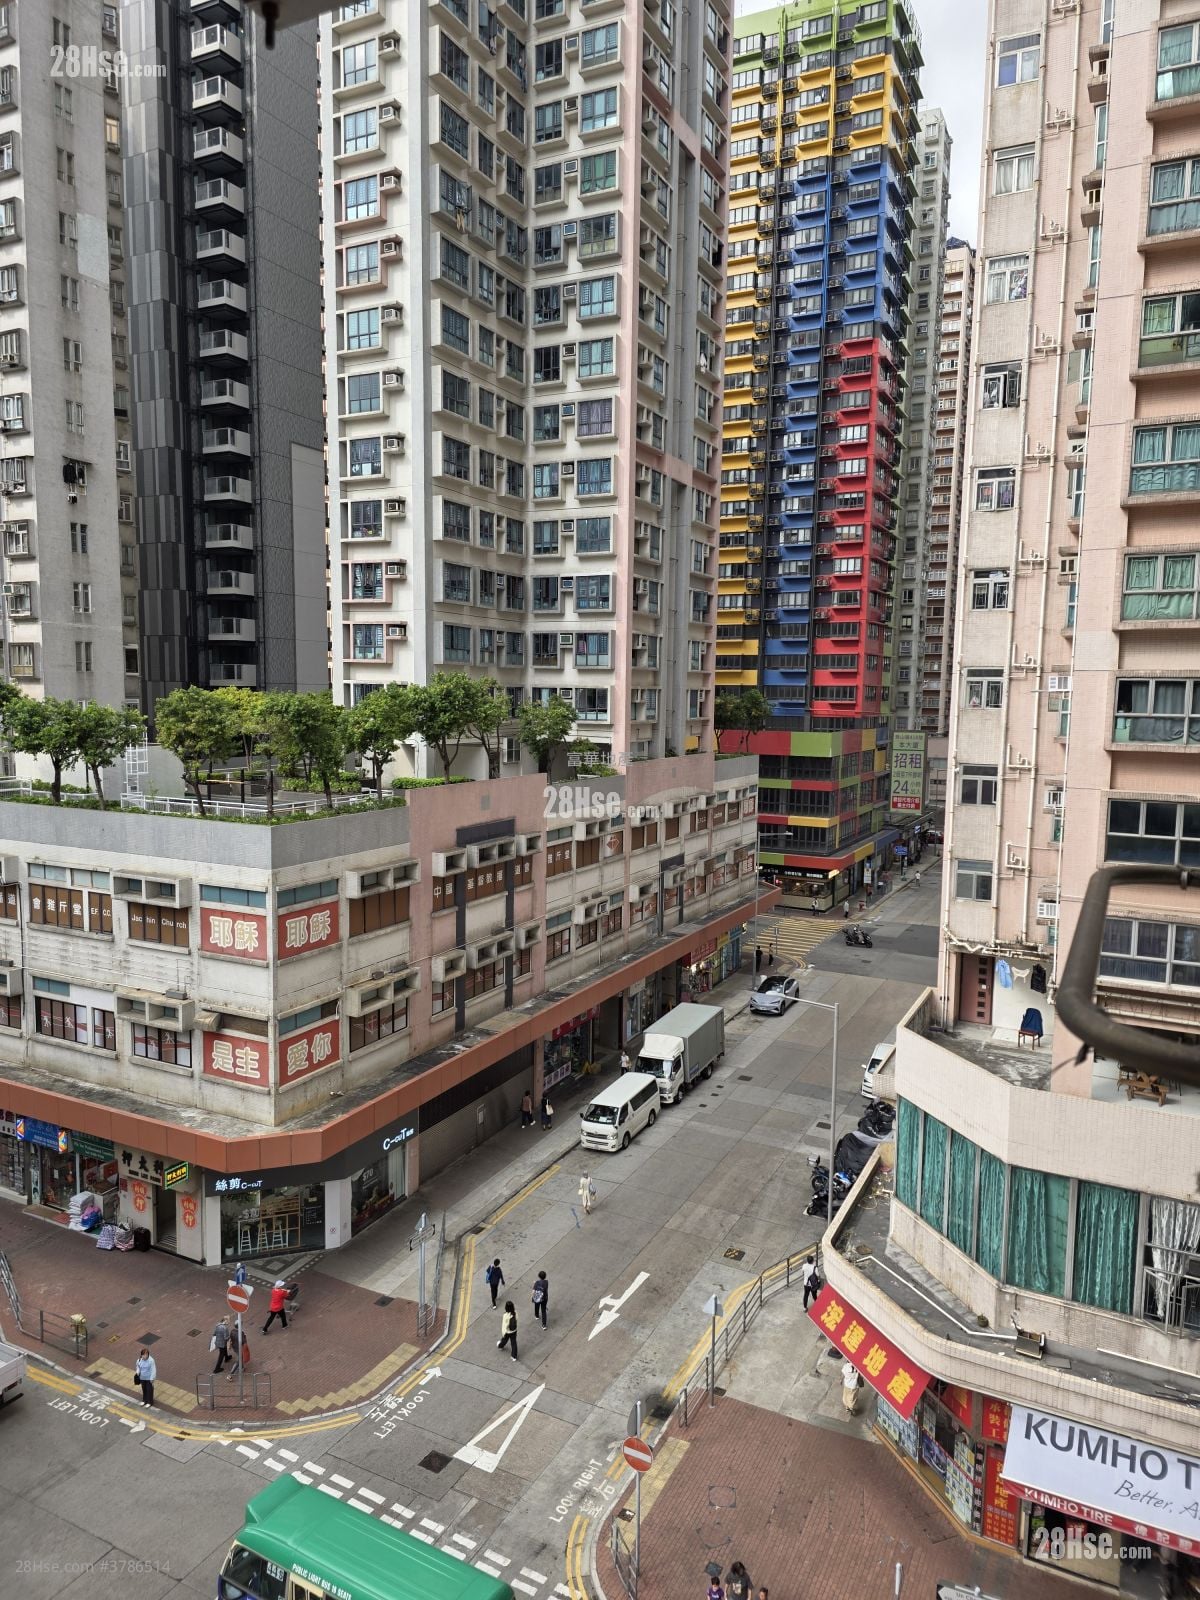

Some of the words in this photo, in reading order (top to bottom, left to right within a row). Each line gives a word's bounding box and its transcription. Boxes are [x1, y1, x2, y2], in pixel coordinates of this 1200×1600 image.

[894, 752, 922, 768] 招租
[893, 780, 909, 794] 24
[161, 918, 187, 929] Church
[212, 1039, 261, 1079] 是主
[287, 1032, 332, 1076] 愛你
[47, 1397, 79, 1414] LEFT
[397, 1390, 431, 1417] LOOK
[75, 1408, 110, 1428] LOOK
[373, 1415, 404, 1439] LEFT
[1024, 1412, 1169, 1481] KUMHO
[548, 1490, 579, 1523] LOOK
[572, 1458, 603, 1490] RIGHT
[1113, 1479, 1173, 1514] Better,
[1178, 1500, 1200, 1522] A
[1081, 1506, 1113, 1526] TIRE
[291, 1563, 308, 1578] PUBLIC
[308, 1572, 321, 1585] LIGHT
[321, 1579, 331, 1591] BUS
[337, 1588, 352, 1600] SEATS
